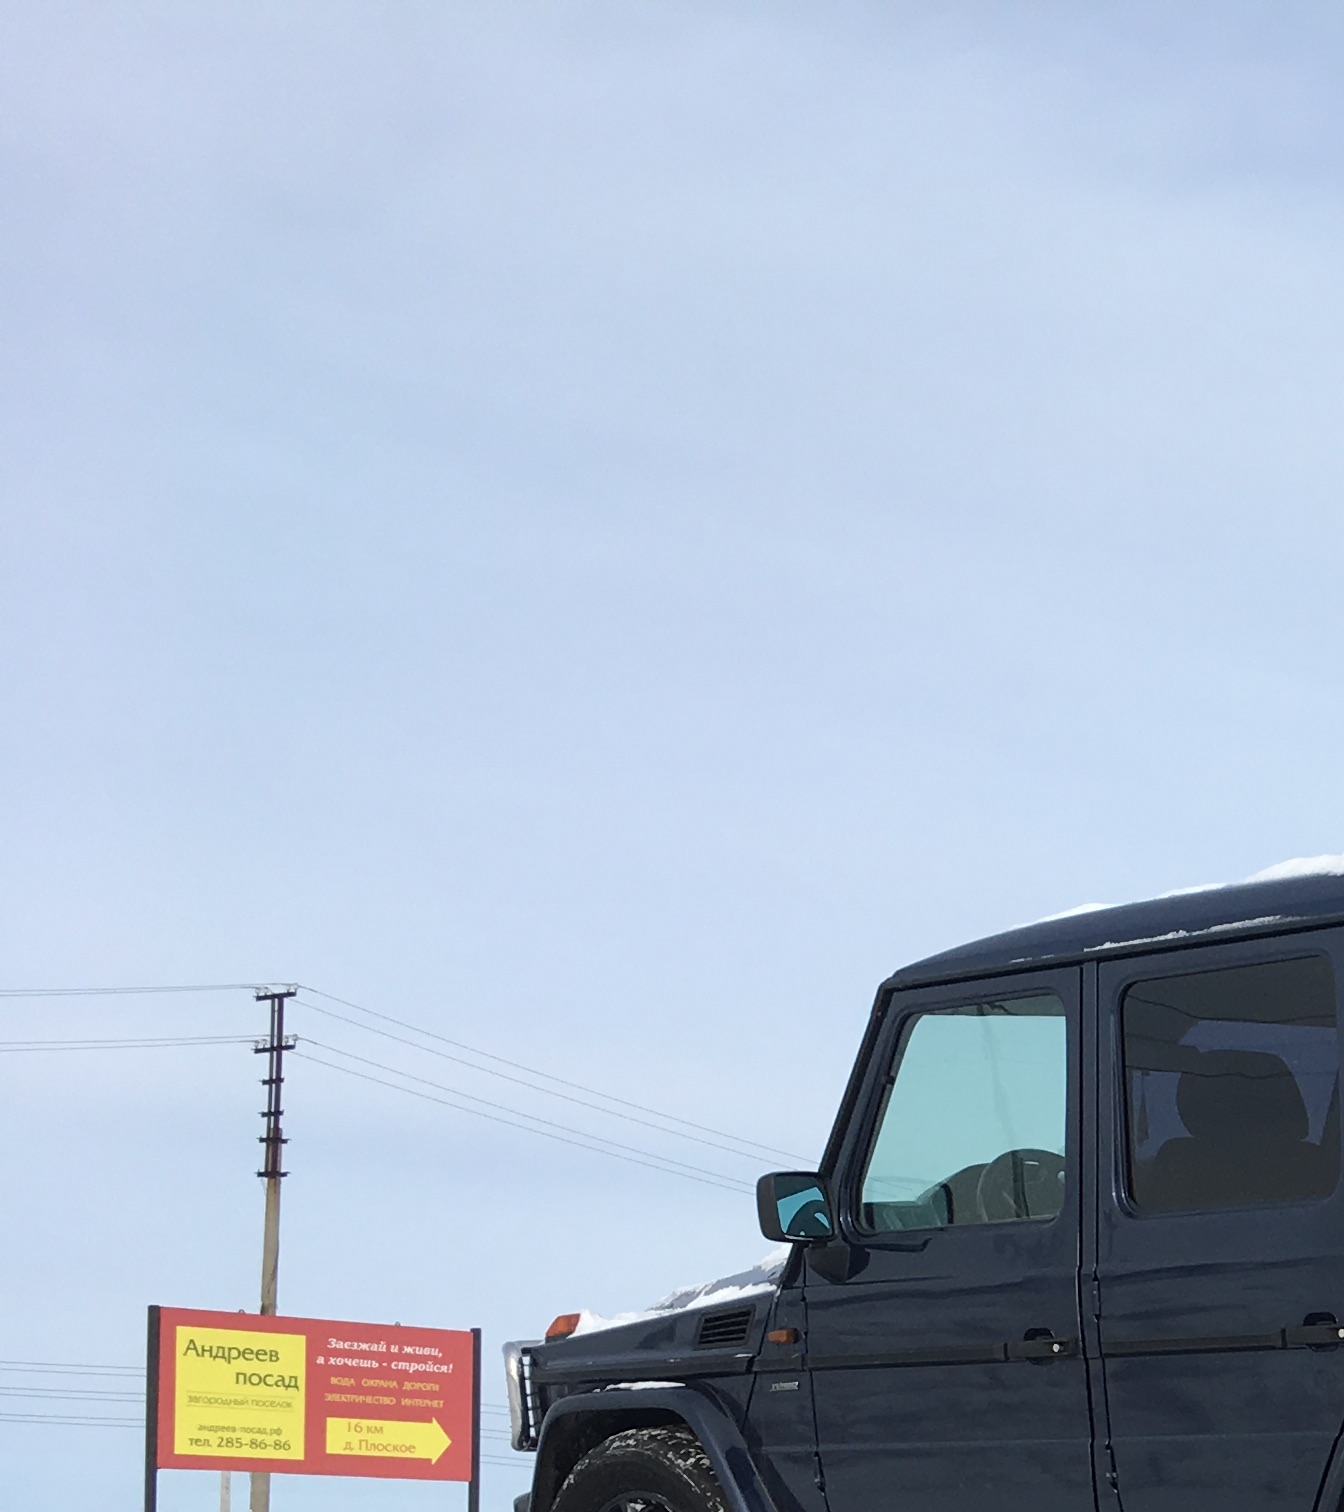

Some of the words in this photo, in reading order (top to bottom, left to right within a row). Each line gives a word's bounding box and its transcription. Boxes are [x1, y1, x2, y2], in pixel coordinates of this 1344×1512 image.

[183, 1339, 280, 1364] Андреев
[327, 1338, 386, 1353] Заезжай
[390, 1344, 398, 1353] и
[402, 1345, 442, 1358] живи,
[316, 1355, 325, 1365] а
[328, 1356, 378, 1368] хочешь
[391, 1361, 453, 1373] стройся!
[235, 1371, 299, 1391] посад
[330, 1377, 355, 1387] ВОДА
[187, 1395, 249, 1407] загородный
[251, 1399, 293, 1409] поселок
[324, 1393, 397, 1405] ЭЛЕКТРИЧЕСТВО
[401, 1398, 444, 1408] ИНТЕРНЕТ
[347, 1422, 364, 1434] 16
[366, 1425, 384, 1435] км
[188, 1437, 212, 1448] тел.
[216, 1436, 291, 1452] 285-86-86
[358, 1439, 416, 1454] Плоское
